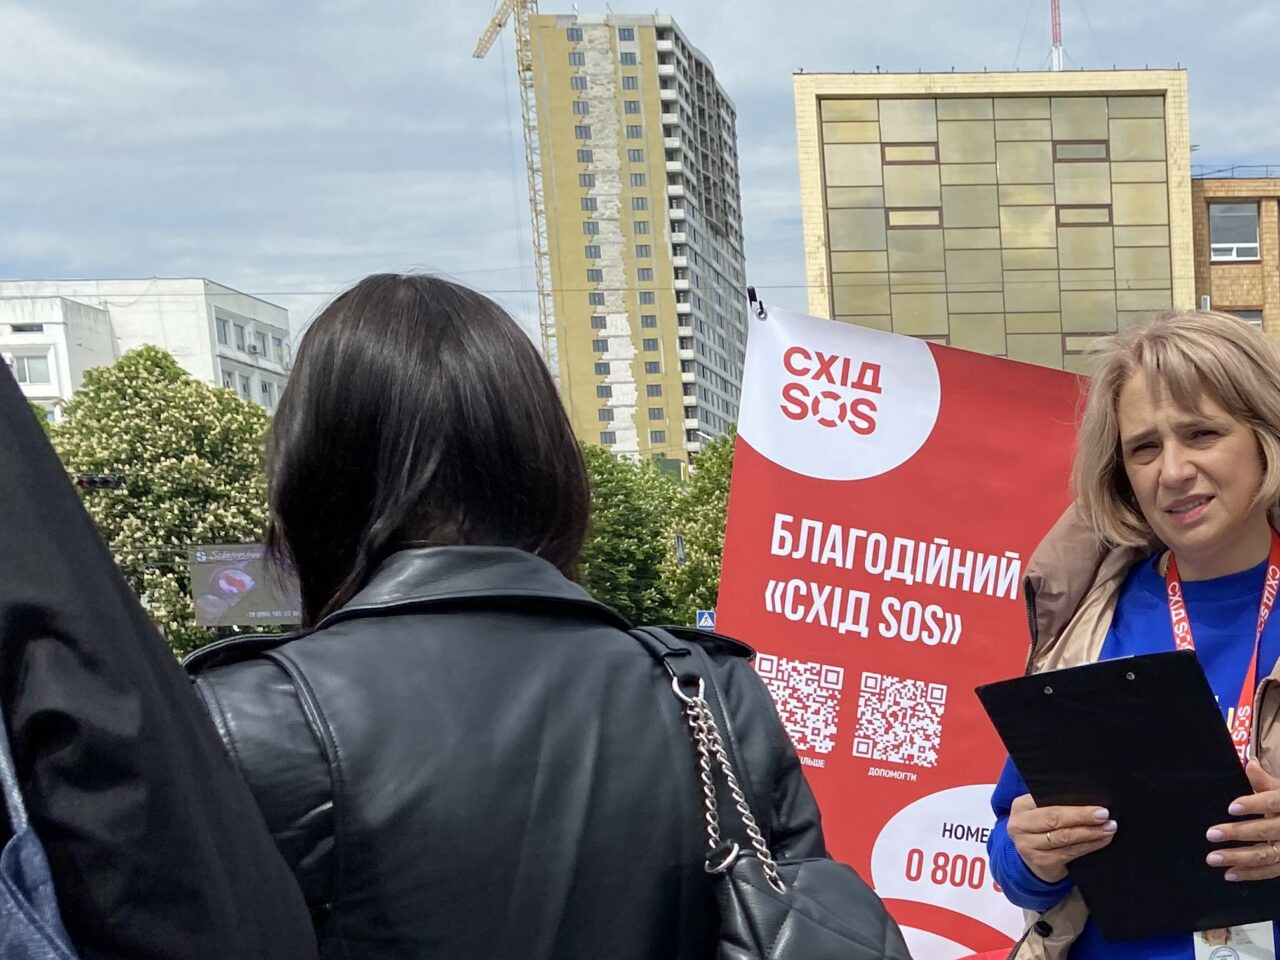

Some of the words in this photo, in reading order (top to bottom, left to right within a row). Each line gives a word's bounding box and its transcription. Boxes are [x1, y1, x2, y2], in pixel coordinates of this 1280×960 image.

[782, 346, 882, 394] СХІД
[779, 382, 878, 435] SOS
[770, 513, 1022, 600] БЛАГОДІЙНИЙ
[1167, 581, 1185, 622] СХІД
[1260, 565, 1280, 606] СХІД
[764, 578, 871, 639] «СХІД
[879, 596, 962, 645] SOS»
[868, 767, 917, 782] ДОПОМОГТИ
[941, 822, 990, 843] НОМЕ
[905, 848, 923, 882] 0
[931, 852, 985, 889] 800
